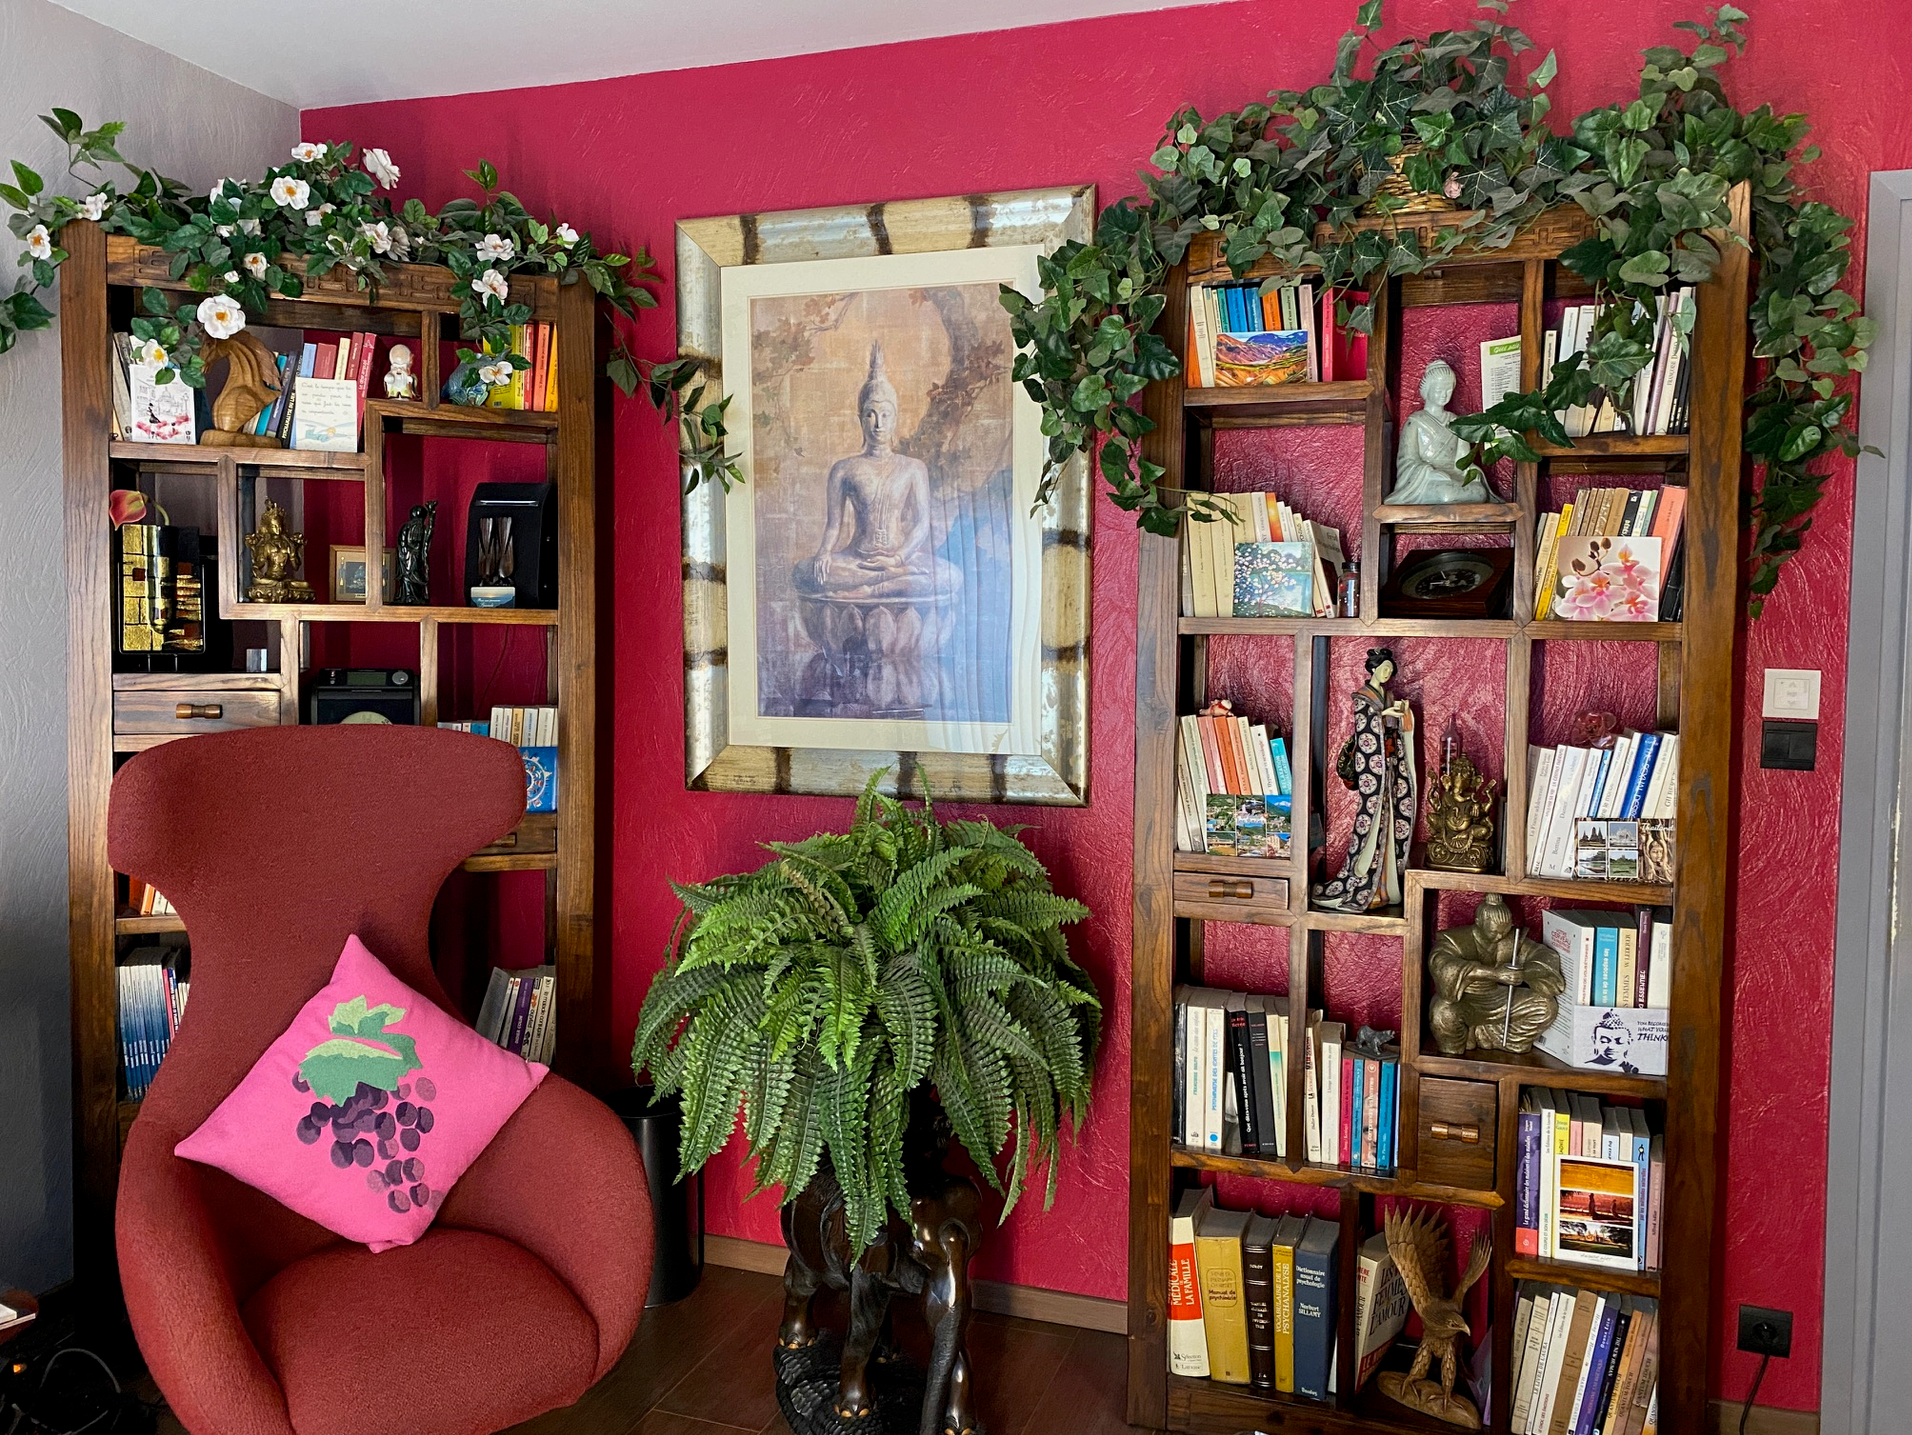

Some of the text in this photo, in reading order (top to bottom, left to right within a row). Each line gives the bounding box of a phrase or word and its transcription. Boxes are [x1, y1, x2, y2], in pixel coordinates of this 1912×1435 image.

[282, 408, 293, 439] PSYCHANALYSE
[1637, 1033, 1668, 1041] THINK
[1242, 1085, 1250, 1098] après
[1276, 1262, 1281, 1271] LA
[1296, 1265, 1325, 1276] Dictionnaire
[1181, 1258, 1195, 1305] LA FAMILLE
[1276, 1272, 1282, 1283] DE
[1296, 1278, 1325, 1289] psychologie
[1282, 1263, 1290, 1334] PSYCHANALYSE
[1373, 1279, 1408, 1315] FEMMES
[1299, 1303, 1319, 1312] Norbert
[1368, 1295, 1406, 1336] L'AMOUR
[1612, 1347, 1620, 1358] NEW
[1608, 1358, 1617, 1377] HUMAN
